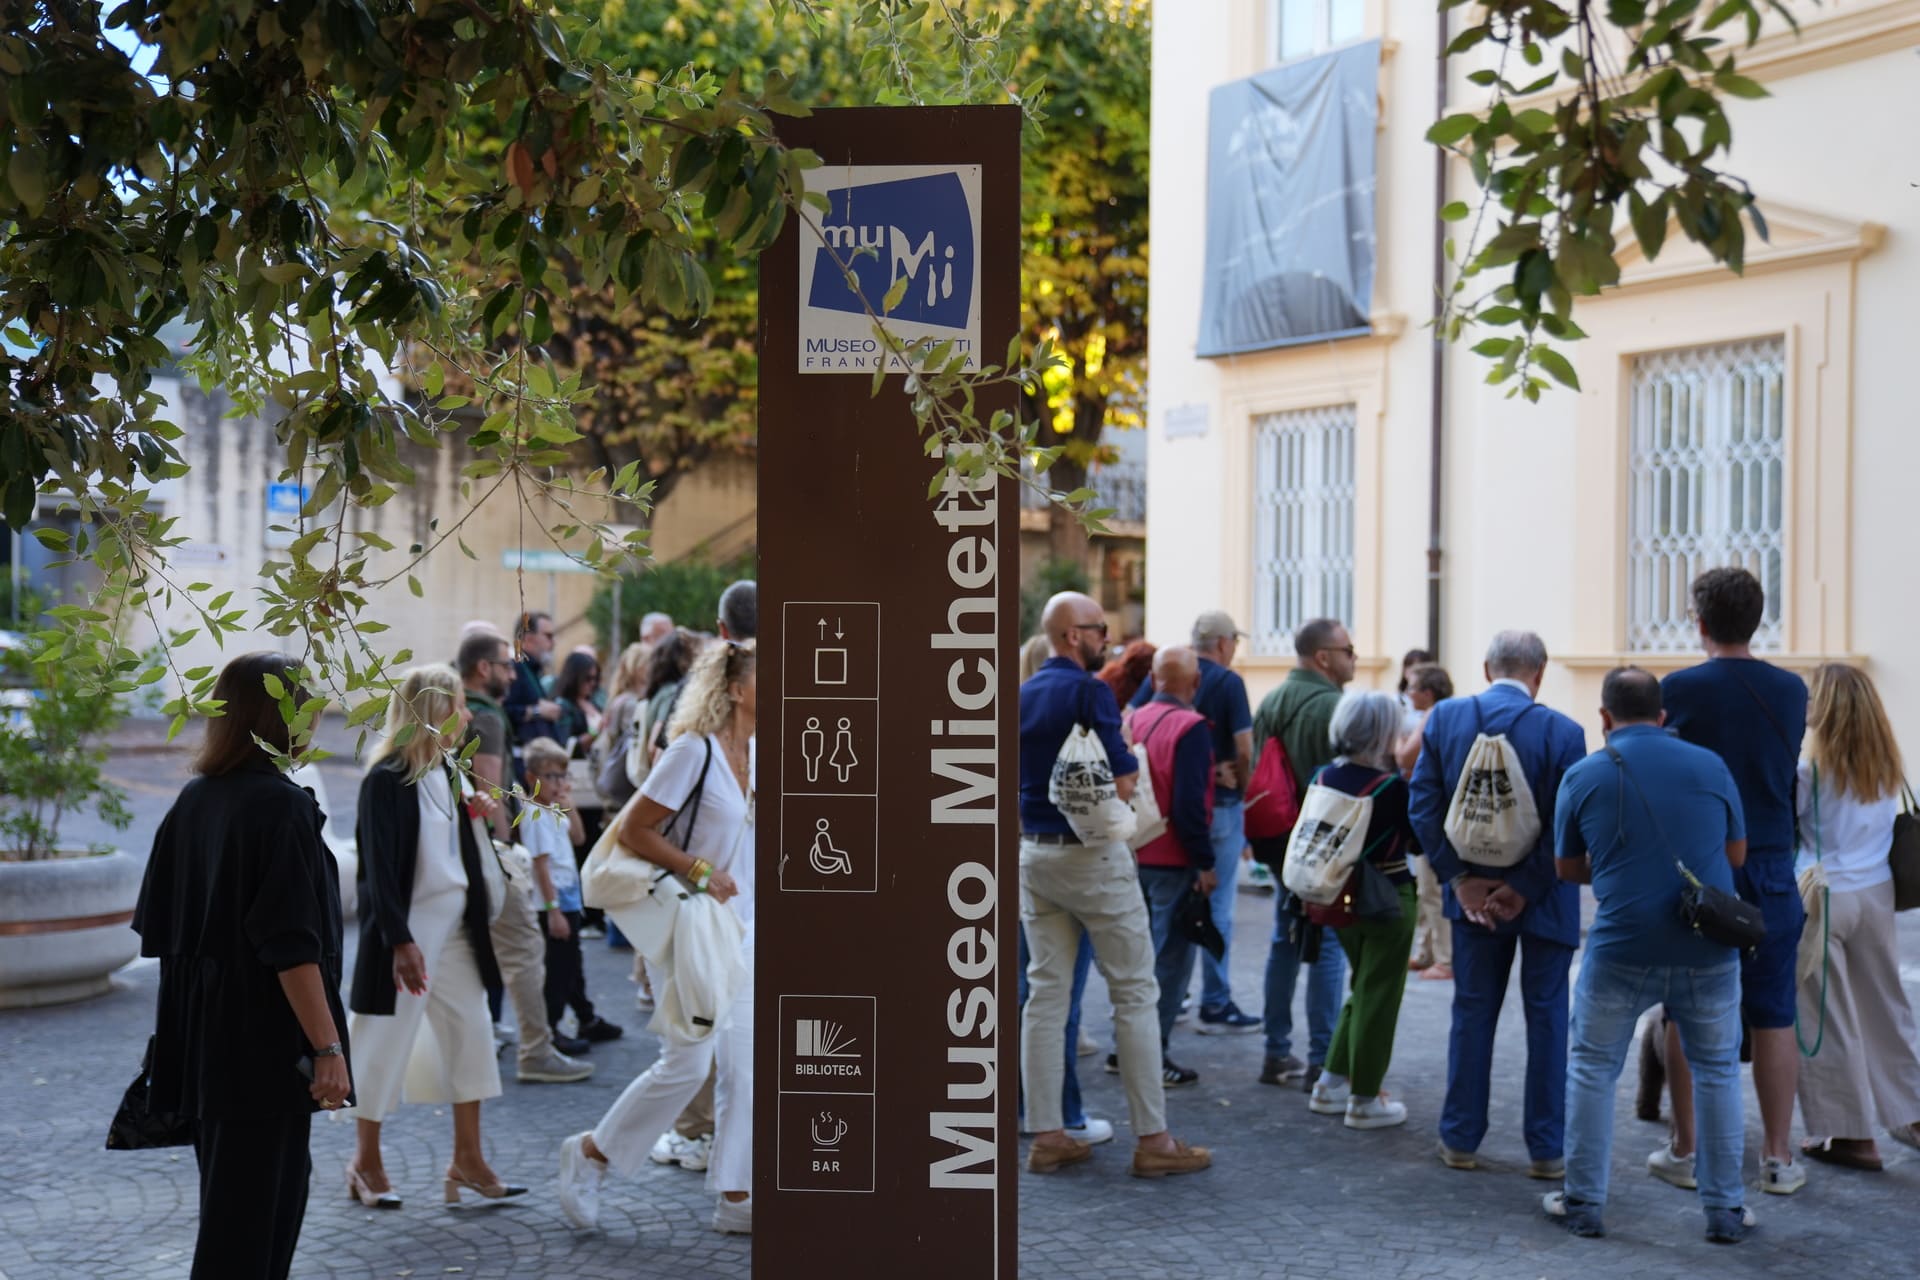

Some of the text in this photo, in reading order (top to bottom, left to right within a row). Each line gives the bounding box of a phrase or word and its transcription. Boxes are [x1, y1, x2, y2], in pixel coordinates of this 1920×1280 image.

[806, 338, 876, 353] MUSEO
[929, 861, 996, 1189] Museo
[795, 1064, 861, 1076] BIBLIOTECA
[812, 1161, 840, 1172] BAR
